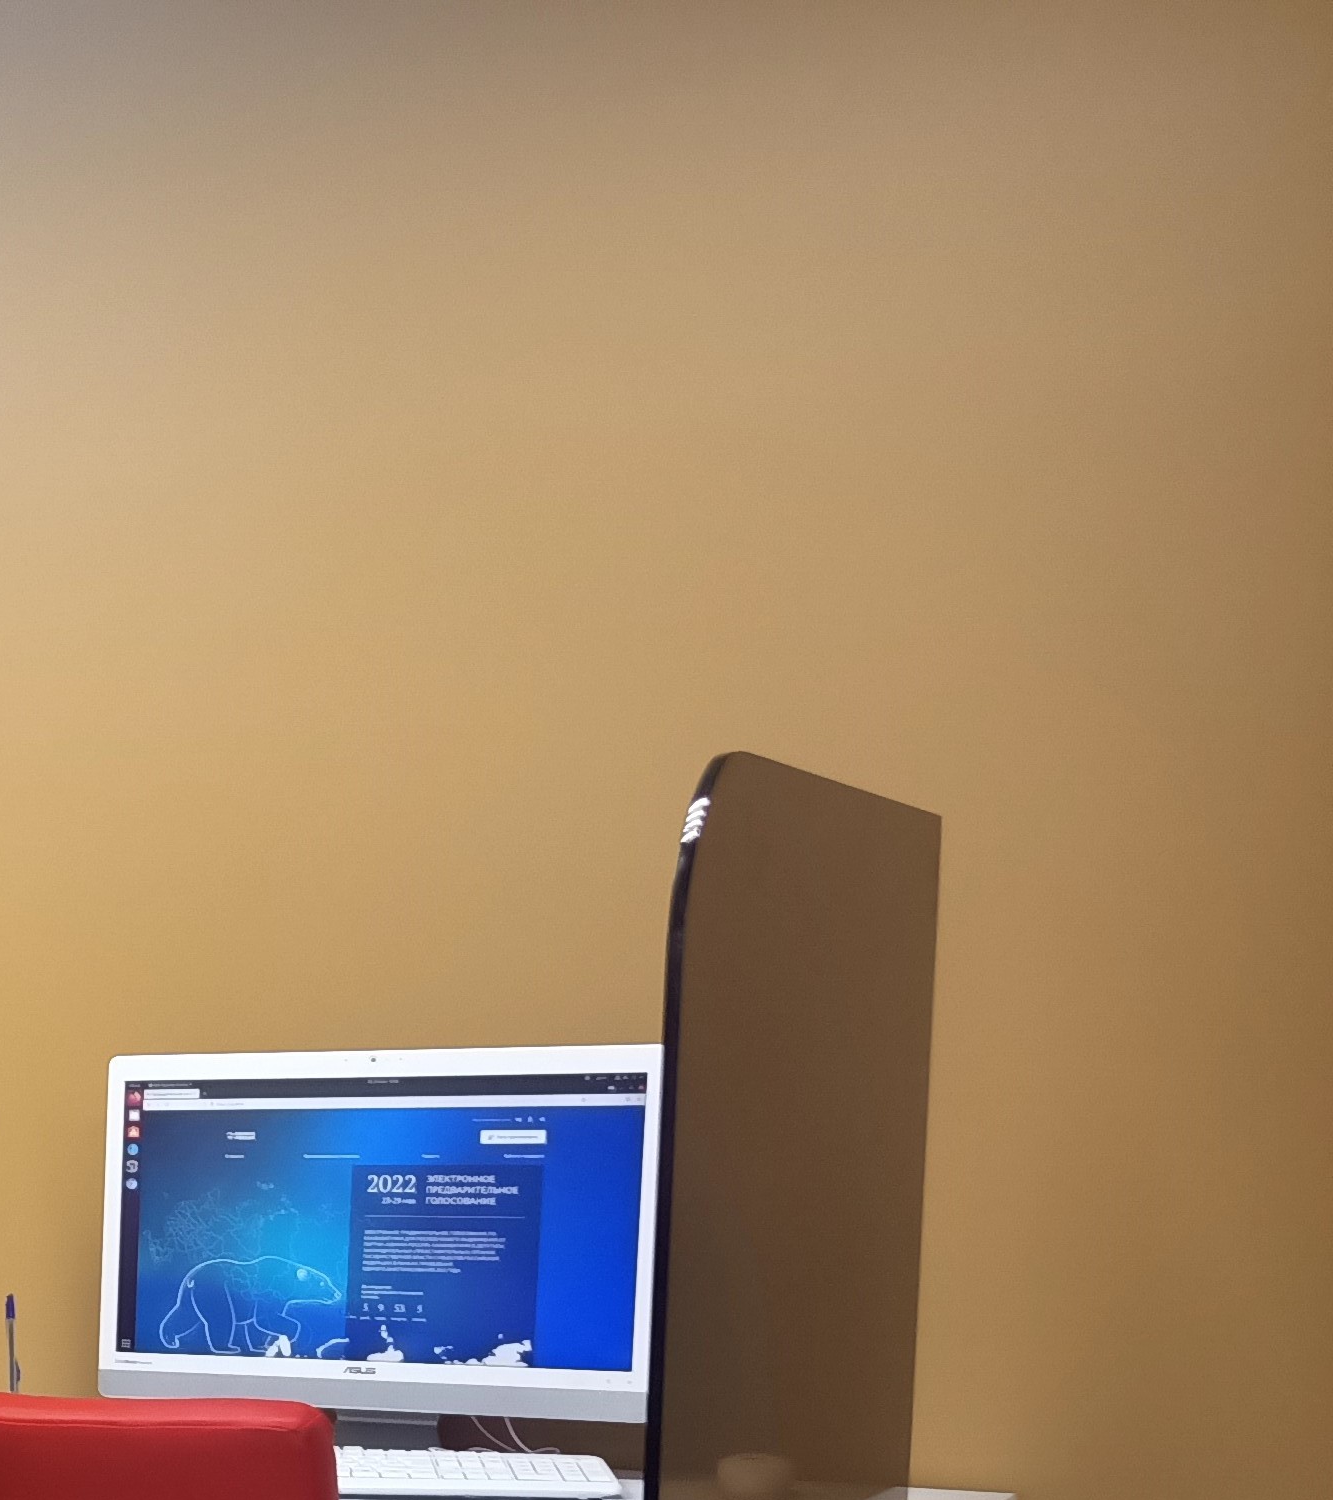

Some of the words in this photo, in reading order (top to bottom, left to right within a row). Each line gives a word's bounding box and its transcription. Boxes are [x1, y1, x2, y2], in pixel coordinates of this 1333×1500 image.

[426, 1175, 496, 1183] ЭЛЕКТРОННОЕ
[367, 1175, 416, 1193] 2022
[425, 1186, 519, 1194] ПРЕДВАРИТЕЛЬНОЕ
[425, 1197, 496, 1205] ГОЛОСОВАНИЕ
[343, 1366, 376, 1375] ASUS
